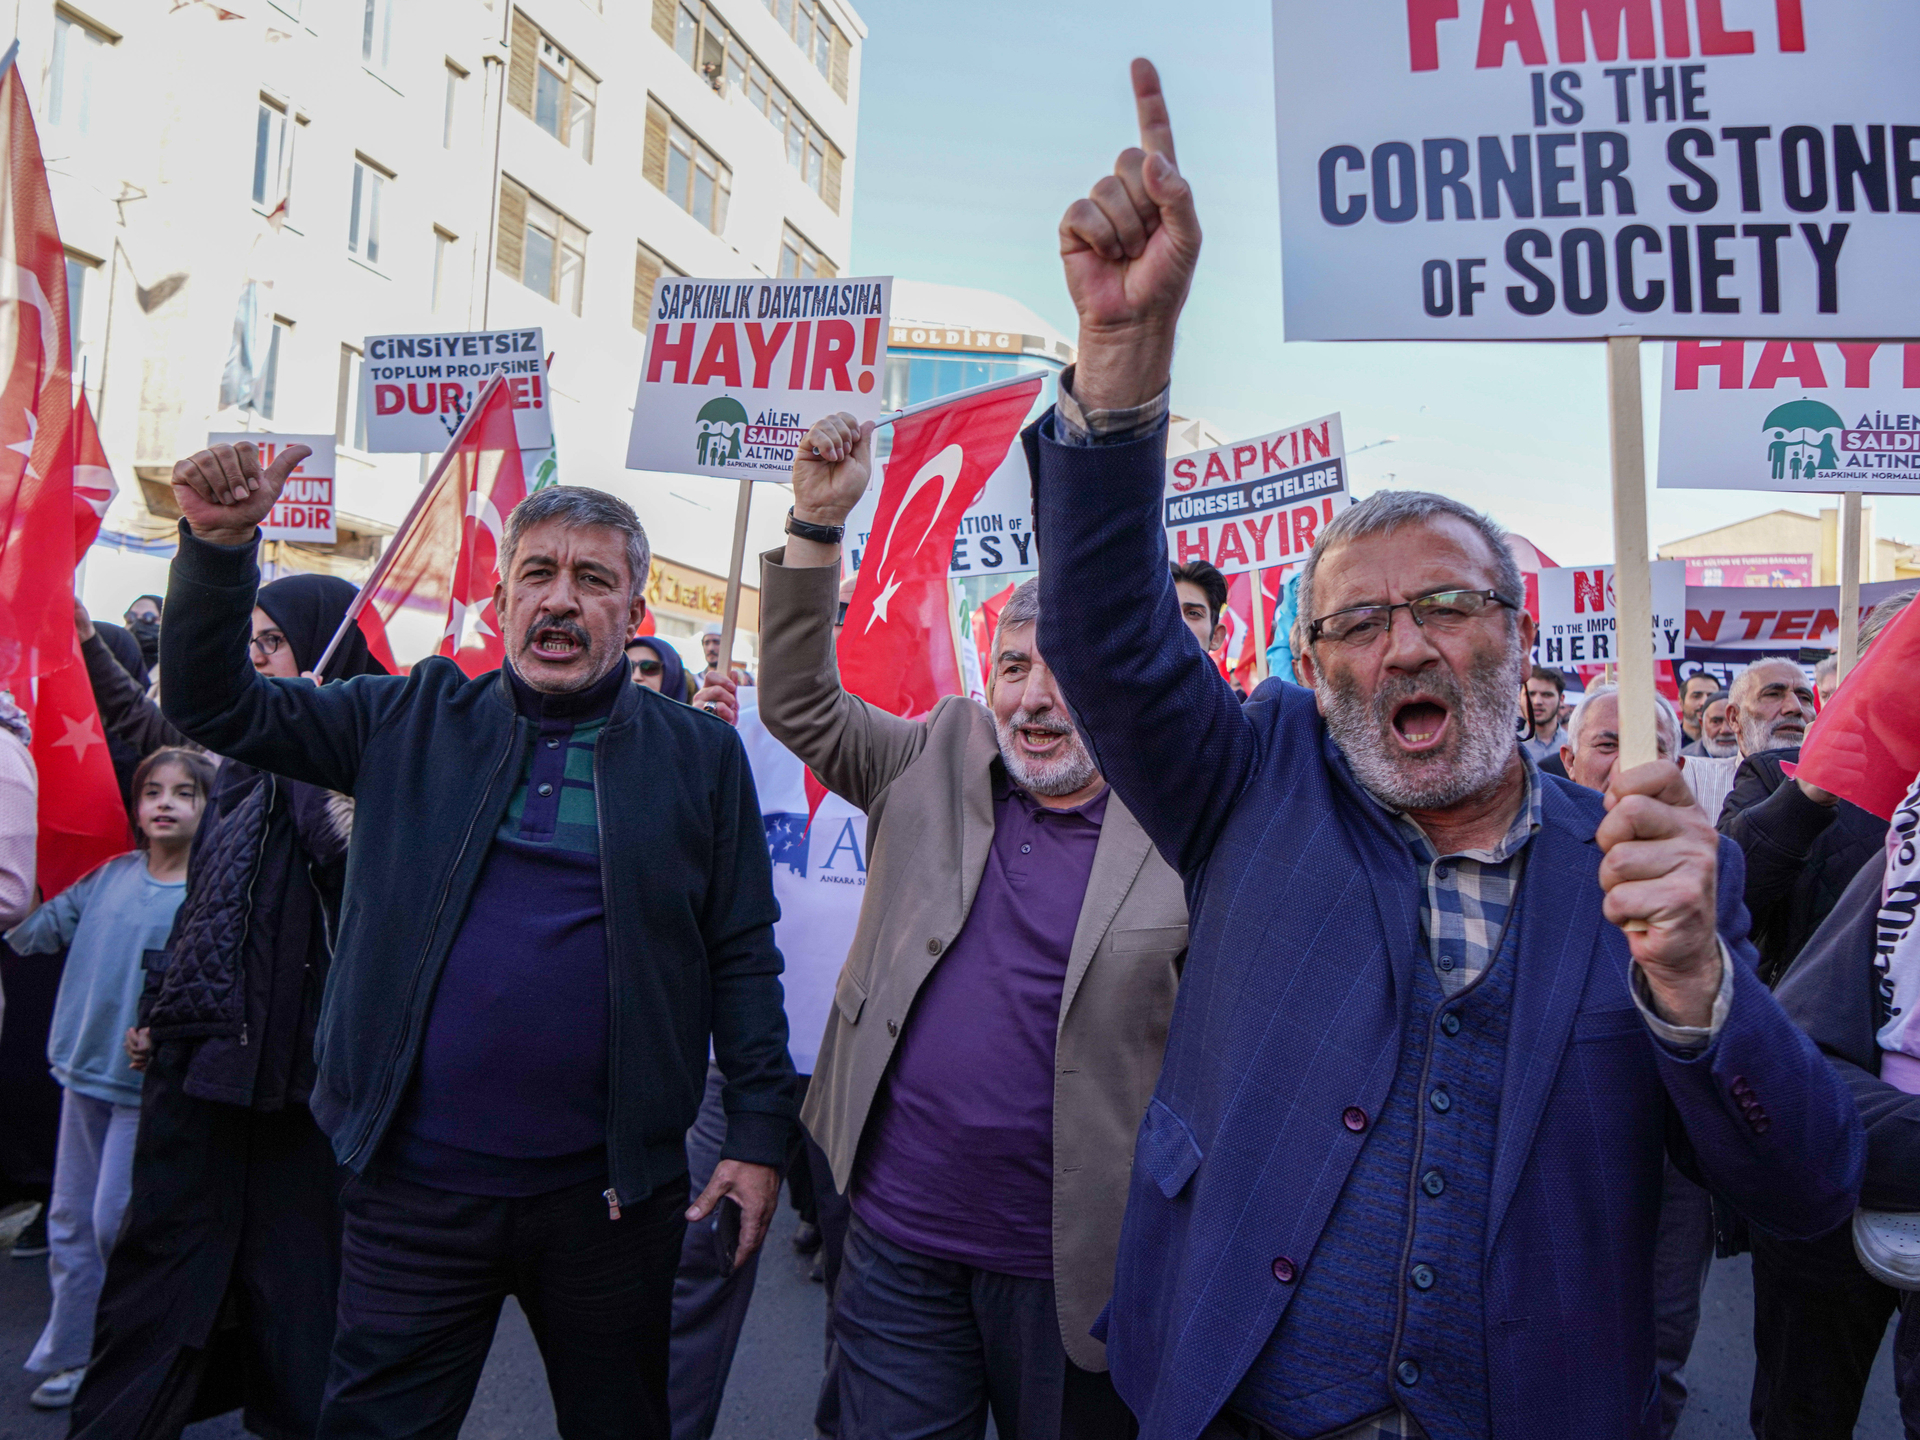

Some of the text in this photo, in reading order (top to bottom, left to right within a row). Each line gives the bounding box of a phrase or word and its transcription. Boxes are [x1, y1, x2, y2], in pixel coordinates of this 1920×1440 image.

[1407, 0, 1806, 72] FAMIL
[1531, 64, 1710, 126] IS THE
[1318, 125, 1920, 226] CORNER STONE
[1422, 223, 1850, 317] OF SOCIETY
[658, 283, 882, 320] SAPKINLIK DAYATMASINA
[371, 365, 442, 380] TOPLUM
[646, 317, 882, 395] HAYIR!
[375, 383, 466, 415] DUR
[726, 460, 758, 470] SAPKINLIK
[745, 446, 796, 462] ALTIND
[1171, 421, 1332, 492] SAPKIN
[1817, 471, 1920, 480] SAPKINLIK NORMALL
[1169, 466, 1338, 521] KÜRESEL ÇETELERE
[957, 514, 1022, 536] ITION OF
[1552, 625, 1564, 636] TO
[1566, 623, 1583, 634] THE
[1663, 618, 1674, 628] OF
[1546, 629, 1680, 663] HERY
[820, 875, 855, 885] ANKARA
